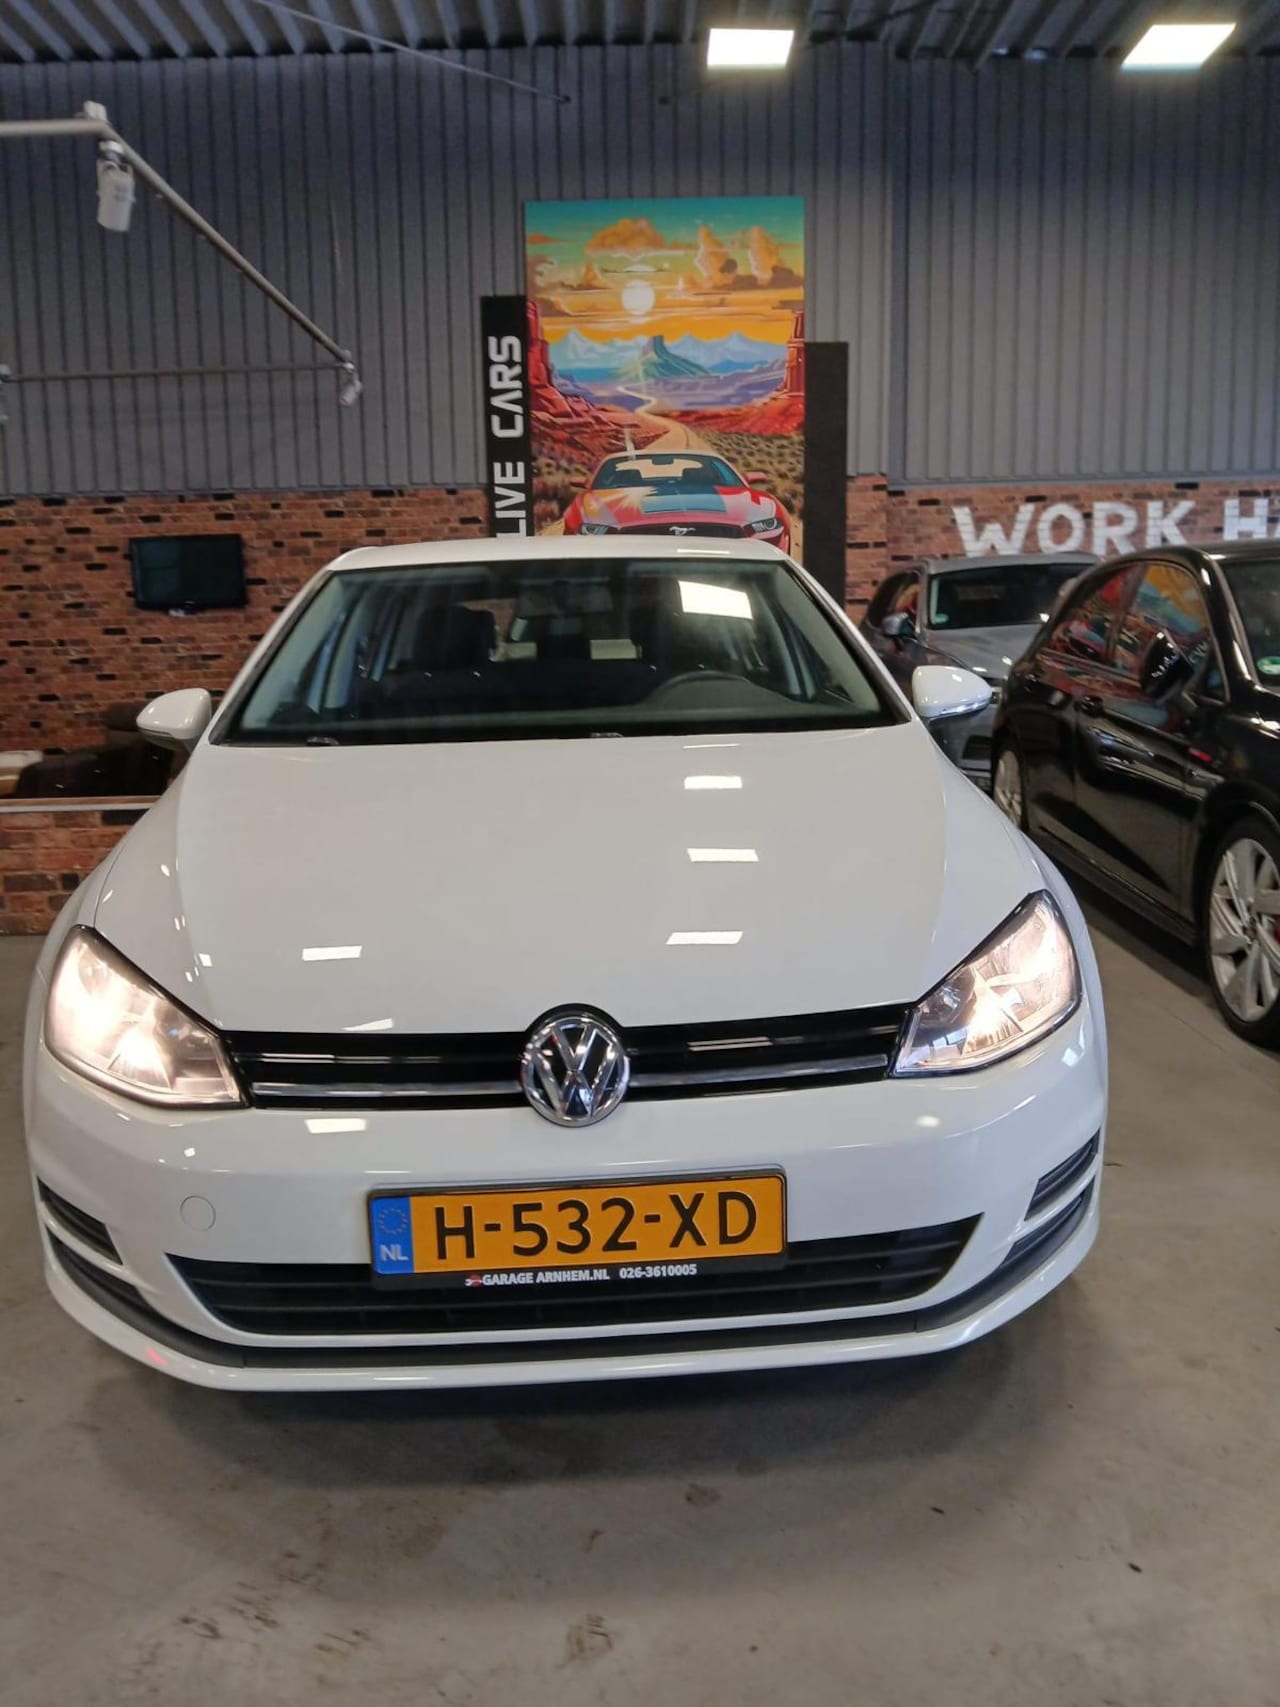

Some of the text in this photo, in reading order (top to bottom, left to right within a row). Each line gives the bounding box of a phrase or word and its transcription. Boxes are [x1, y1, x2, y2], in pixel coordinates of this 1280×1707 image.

[488, 335, 527, 537] LIVE CARS
[952, 498, 1280, 560] WORK H
[525, 1018, 626, 1122] VW
[380, 1244, 408, 1261] NL
[435, 1191, 757, 1260] H-532-XD
[483, 1264, 697, 1286] GARAGE ARNHEM.NL 026-3610005
